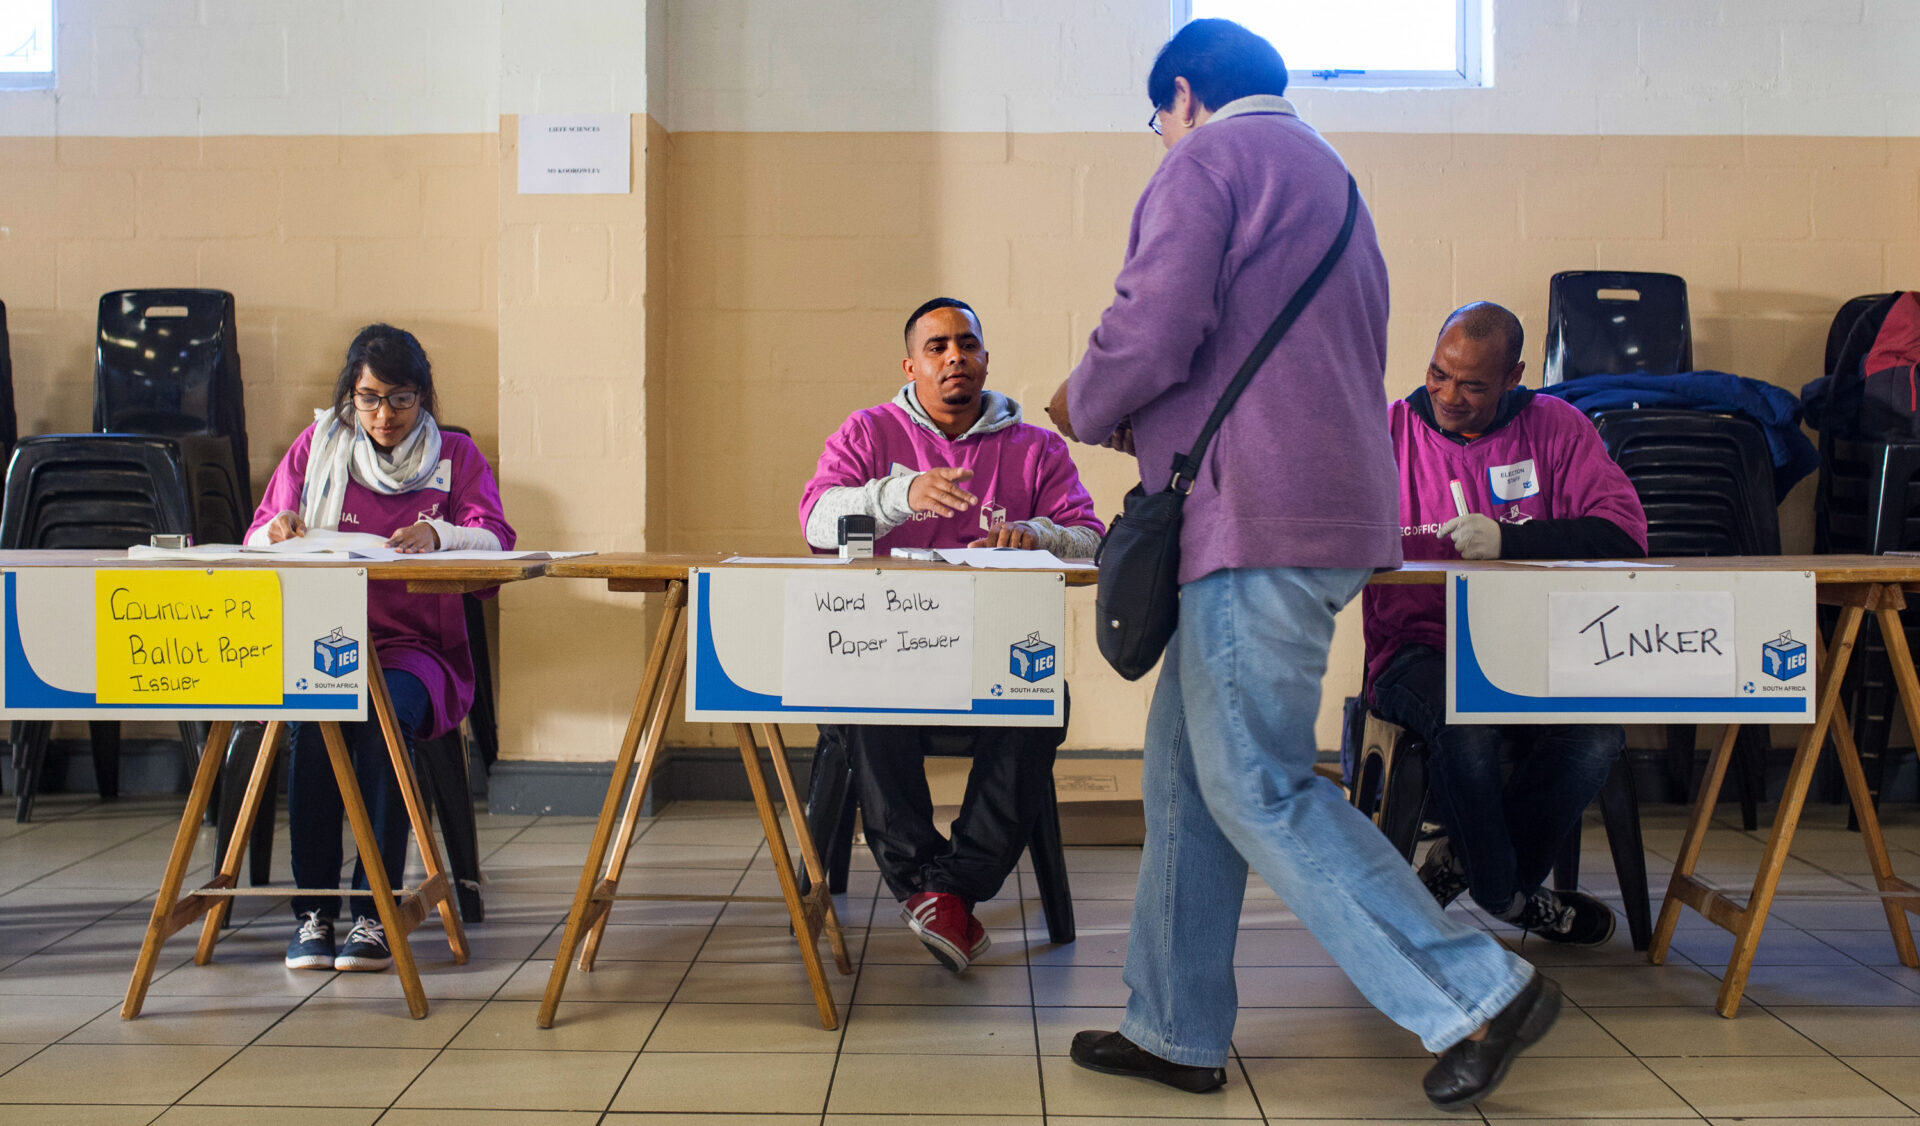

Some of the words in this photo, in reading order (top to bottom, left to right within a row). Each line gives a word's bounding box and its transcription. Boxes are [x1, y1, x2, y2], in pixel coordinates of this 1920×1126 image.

[814, 592, 866, 612] Ward
[828, 630, 887, 657] Paper
[897, 630, 960, 653] Issuer
[1579, 605, 1722, 666] INKER
[129, 634, 208, 665] Ballot
[219, 636, 273, 668] Paper
[339, 649, 357, 667] IEC
[1035, 654, 1054, 673] IEC
[1787, 653, 1806, 670] IEC
[129, 674, 200, 692] Issuer
